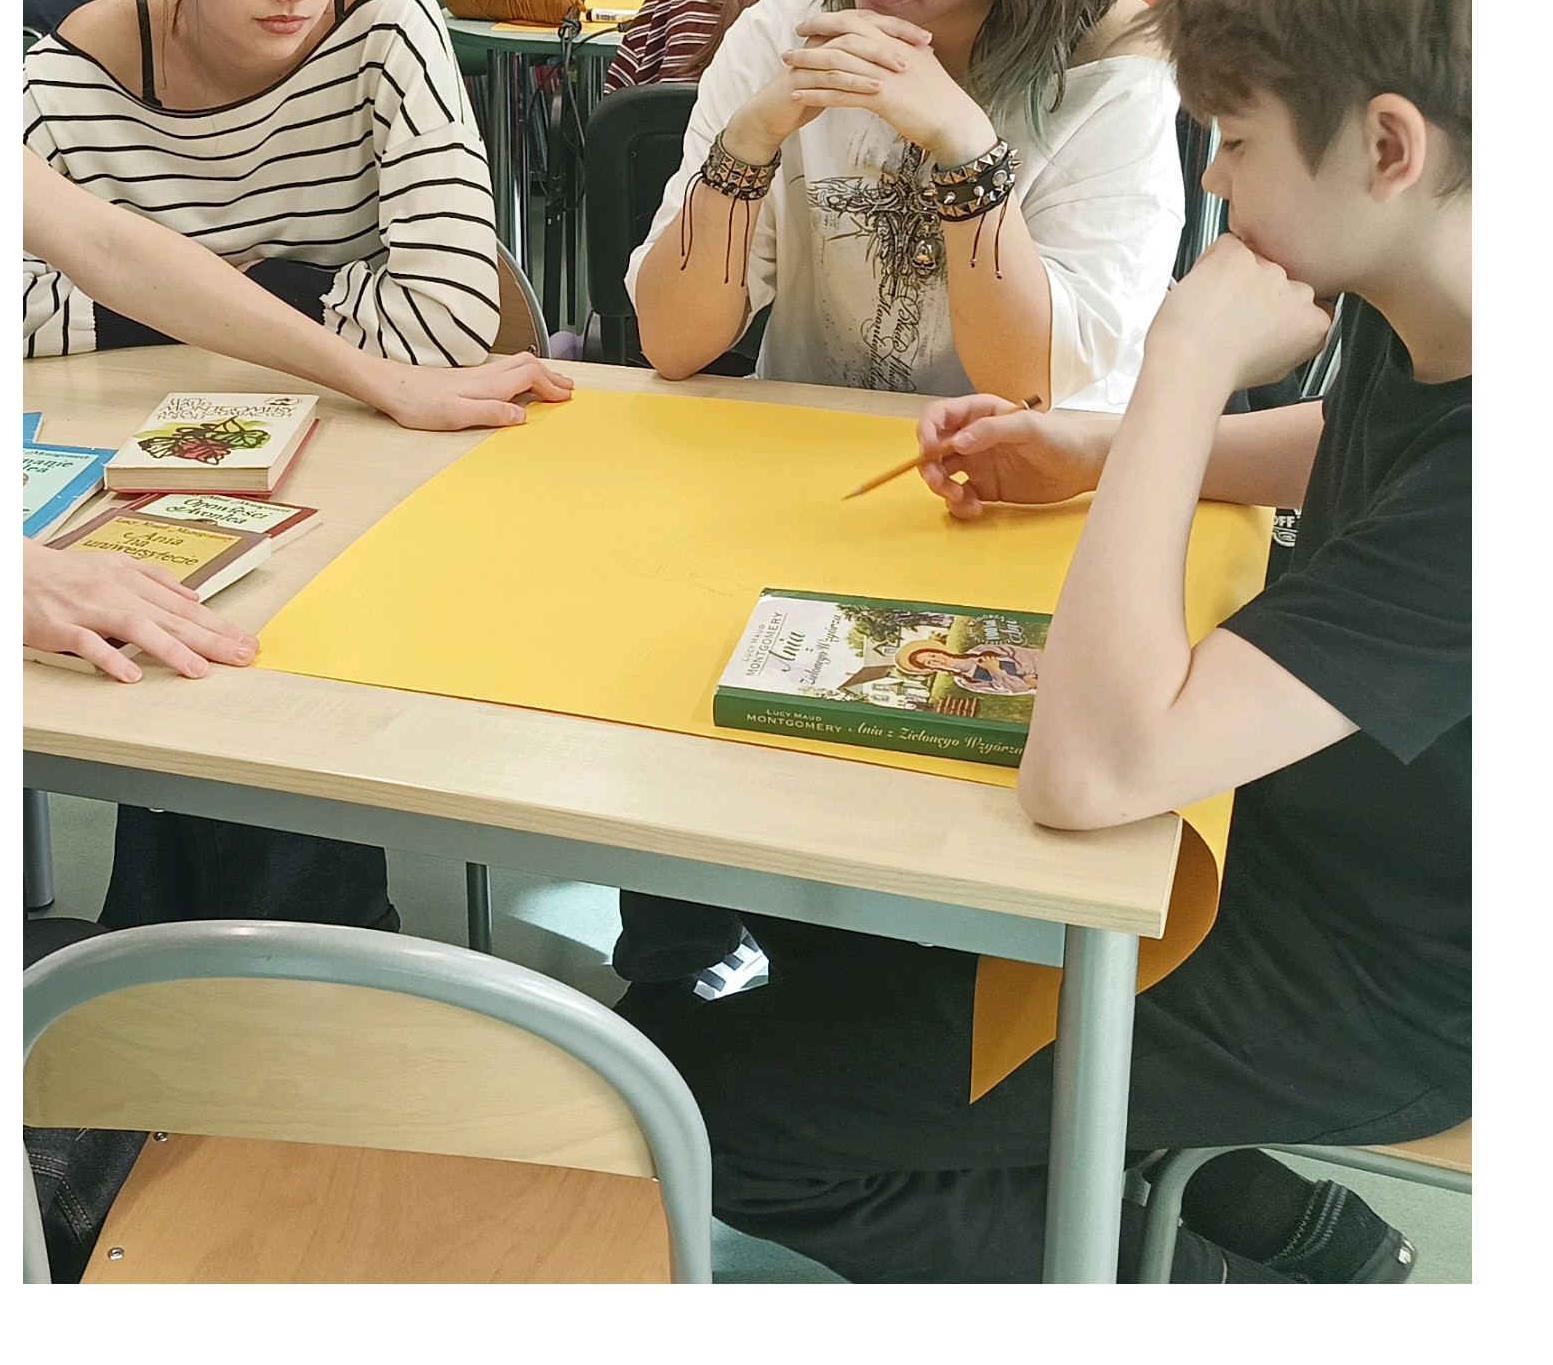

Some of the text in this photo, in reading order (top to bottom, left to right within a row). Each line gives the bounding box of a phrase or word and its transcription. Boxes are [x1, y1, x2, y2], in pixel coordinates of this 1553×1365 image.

[122, 530, 185, 547] Ania
[745, 611, 784, 676] MONTGOMERY
[746, 713, 843, 733] MONTGOMERY
[899, 726, 960, 748] Zielonego
[963, 735, 1024, 755] Wzgórza
